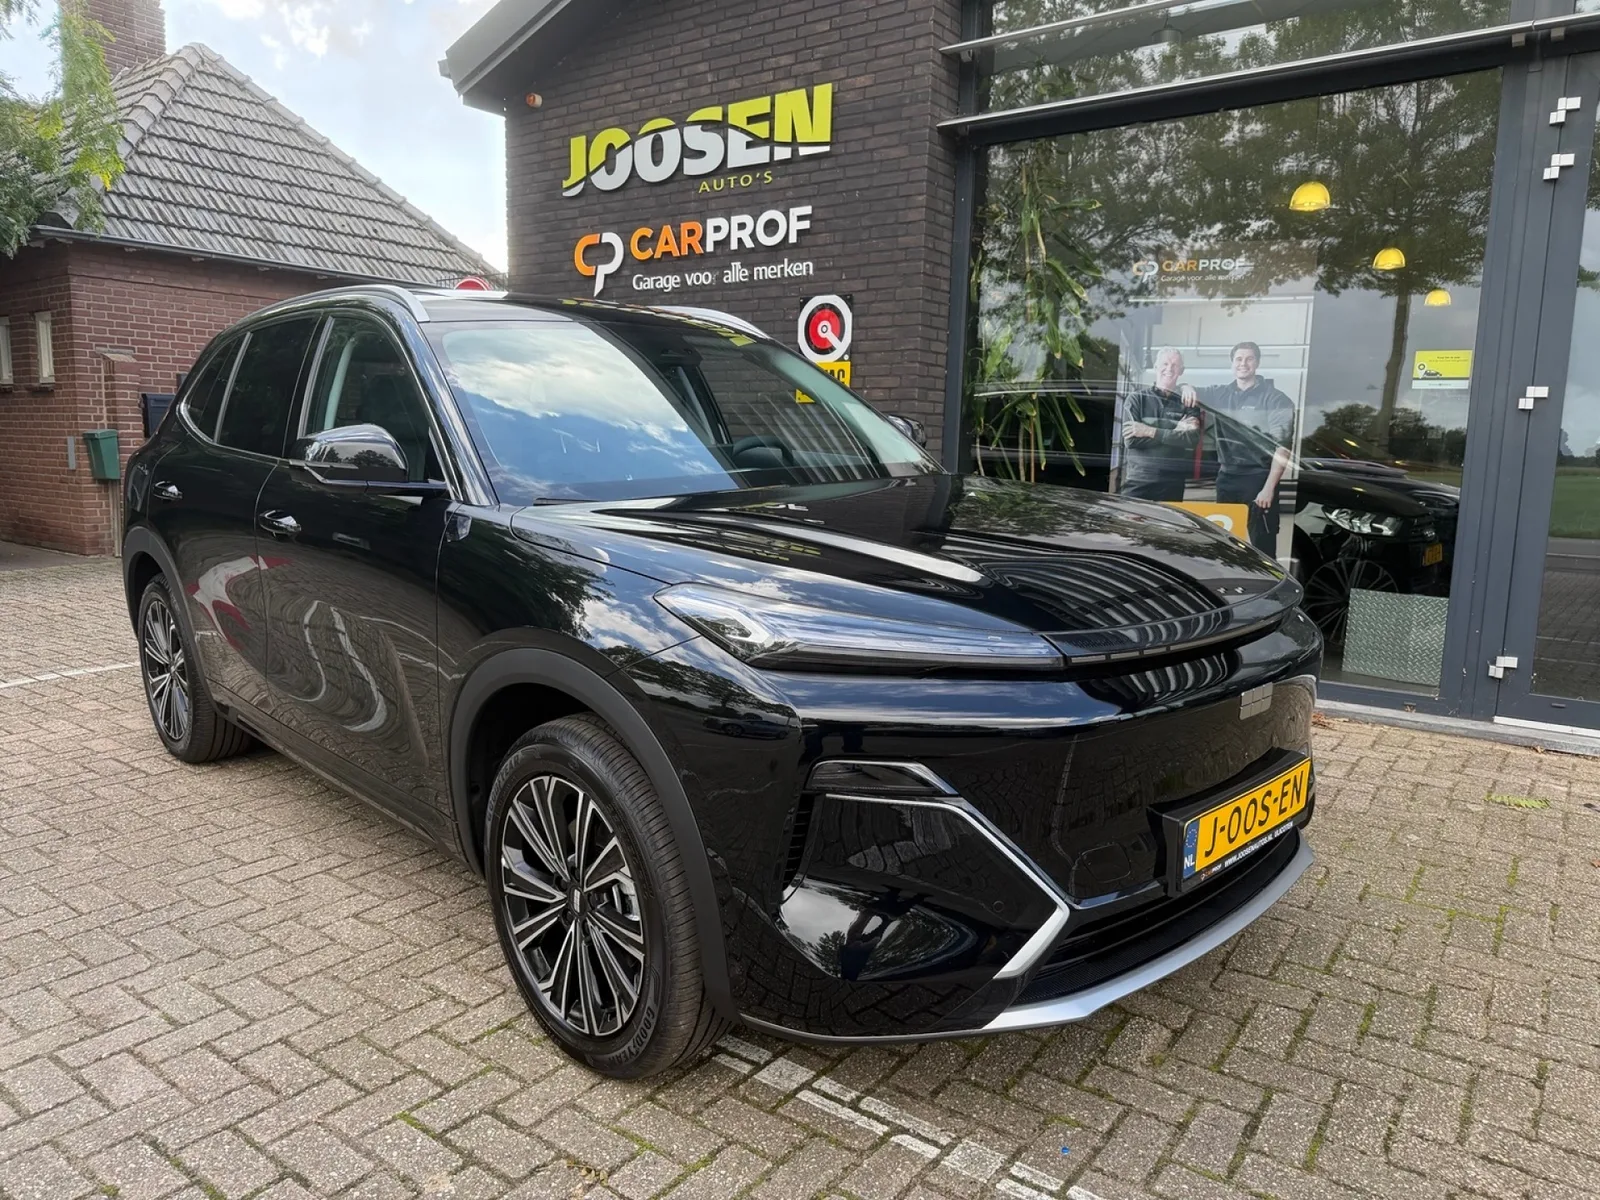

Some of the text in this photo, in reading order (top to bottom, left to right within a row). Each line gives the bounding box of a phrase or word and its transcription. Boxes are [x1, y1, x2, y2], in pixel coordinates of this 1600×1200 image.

[562, 83, 833, 196] JOOSEN
[698, 170, 773, 194] AUTO'S
[630, 205, 813, 261] CARPROF
[632, 274, 681, 293] Garage
[723, 261, 749, 283] alle
[753, 257, 814, 281] merken
[1162, 258, 1246, 272] CARPROF
[1204, 770, 1304, 858] J-OOS-EN
[1183, 854, 1196, 870] NL
[608, 1006, 656, 1065] GOODYEAR
